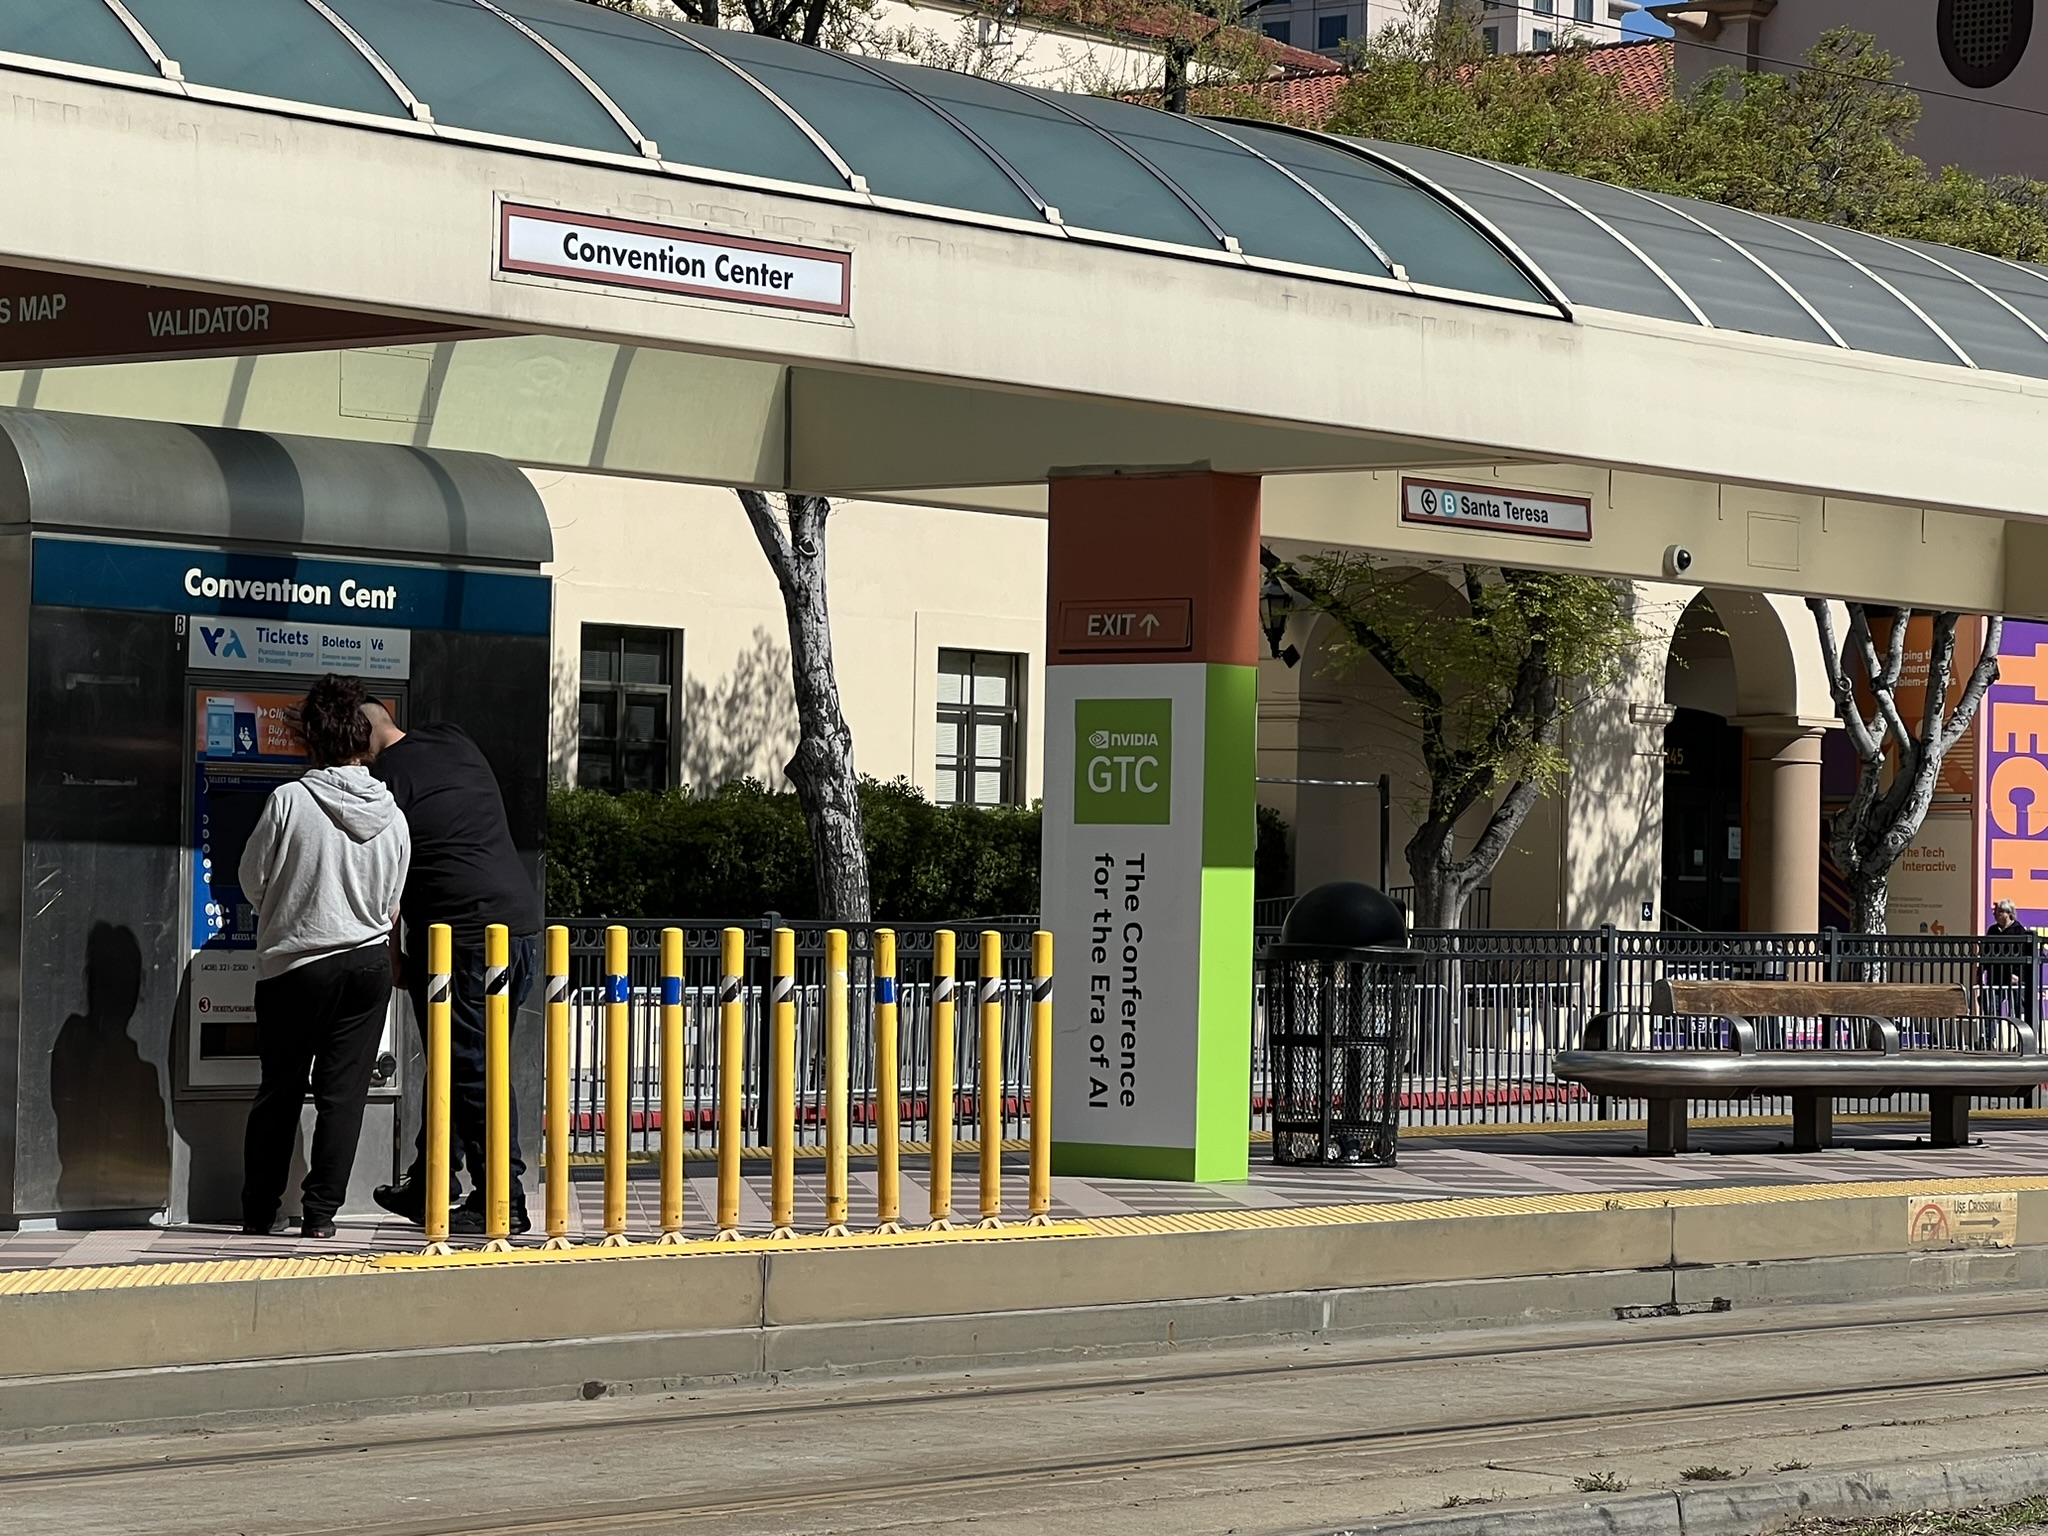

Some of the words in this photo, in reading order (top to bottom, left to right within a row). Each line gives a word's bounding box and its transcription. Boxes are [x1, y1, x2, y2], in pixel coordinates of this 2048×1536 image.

[563, 232, 705, 278] Convention
[715, 254, 793, 290] Center
[19, 293, 67, 321] MAP
[148, 304, 270, 337] VALIDATOR
[1461, 496, 1500, 518] Santa
[1503, 501, 1549, 524] Teresa
[184, 567, 331, 606] Convention
[339, 579, 397, 609] Cent
[256, 626, 309, 646] Tickets
[1087, 612, 1136, 637] EXIT
[322, 636, 361, 649] Boletos
[371, 638, 384, 651] Vé
[268, 725, 284, 737] Buy
[1087, 755, 1159, 794] GTC
[1902, 860, 1957, 872] Interactive
[1921, 846, 1945, 858] Tech
[1093, 853, 1115, 900] for
[1124, 853, 1146, 912] The
[1091, 908, 1113, 964] the
[201, 963, 217, 972] (408)
[1090, 975, 1111, 1024] Era
[1119, 922, 1144, 1108] Conference
[1089, 1034, 1110, 1069] of
[1088, 1076, 1109, 1108] AI
